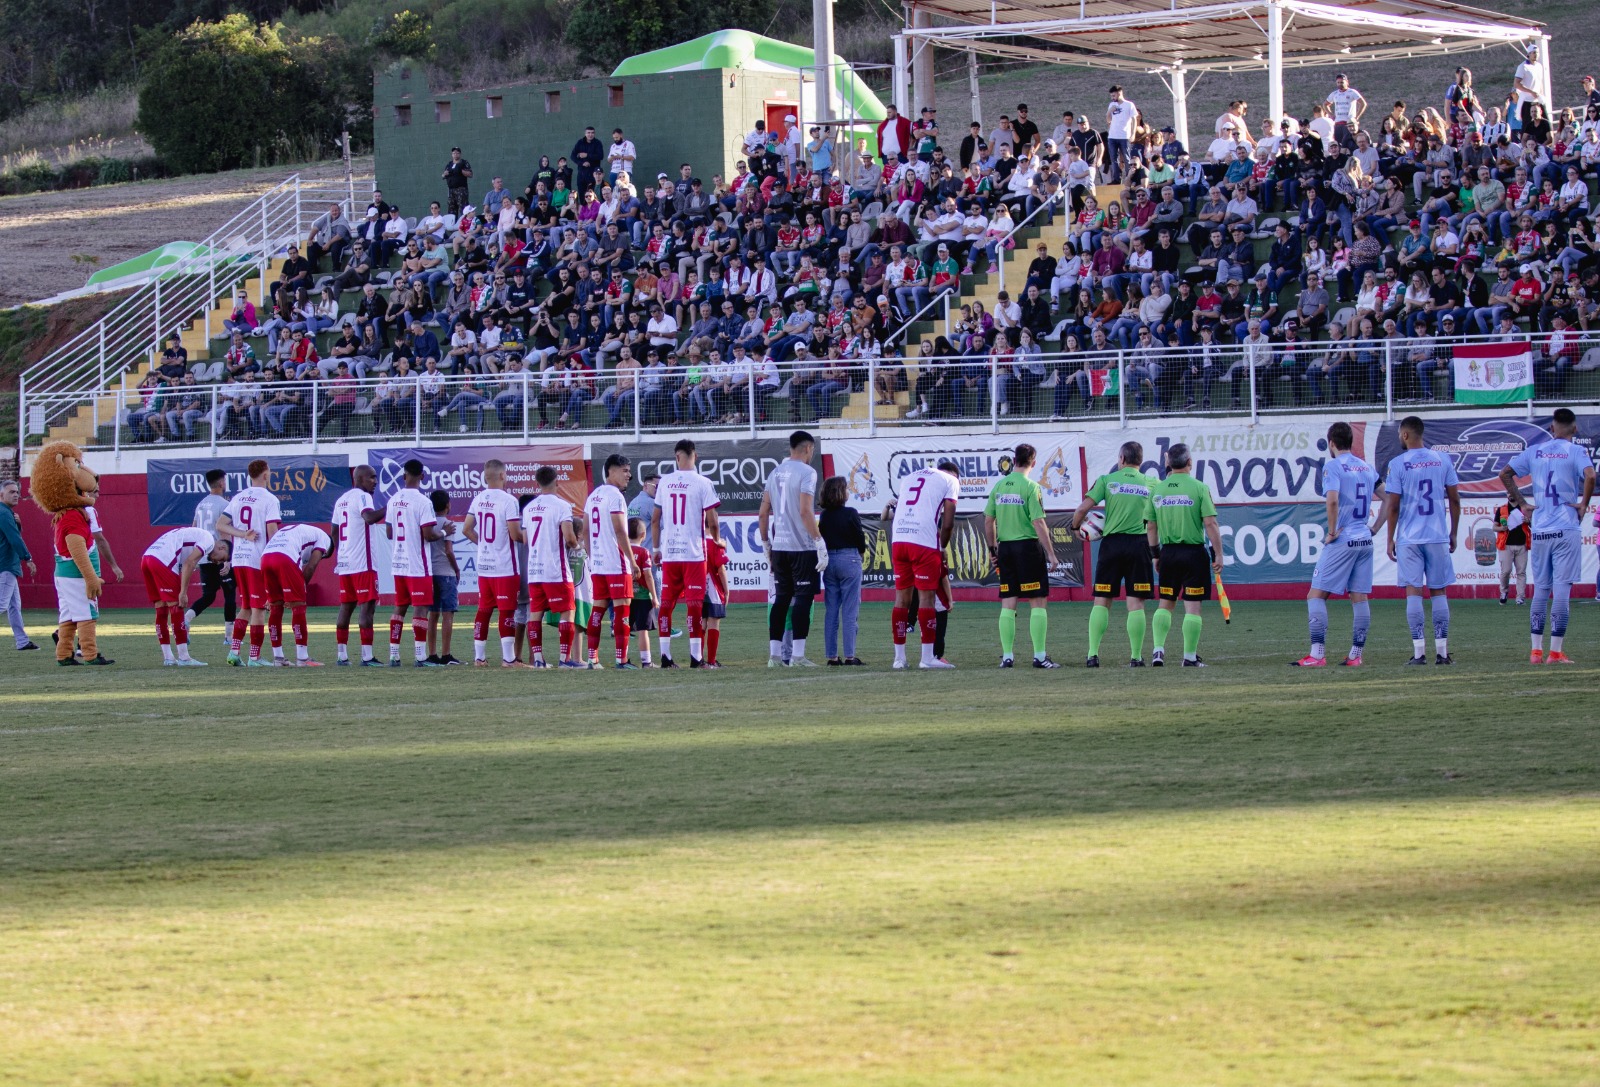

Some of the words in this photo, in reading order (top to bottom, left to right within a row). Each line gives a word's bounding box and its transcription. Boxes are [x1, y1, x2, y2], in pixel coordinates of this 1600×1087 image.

[267, 465, 306, 491] GÁS
[420, 464, 489, 490] Crediso
[506, 473, 531, 484] negócio
[1544, 470, 1560, 507] 4
[717, 492, 730, 500] ARA
[779, 481, 787, 514] 1
[906, 477, 926, 506] 3
[1162, 498, 1176, 506] São
[1352, 482, 1367, 519] 5
[1418, 479, 1434, 516] 3
[240, 505, 253, 532] 9
[669, 493, 687, 526] 11
[1453, 506, 1490, 515] TEBOL
[340, 511, 349, 542] 2
[477, 511, 497, 543] 10
[531, 516, 543, 547] 7
[1532, 531, 1564, 541] Unimed
[1209, 523, 1325, 566] COOB
[725, 560, 769, 574] strução
[733, 576, 761, 586] Brasil
